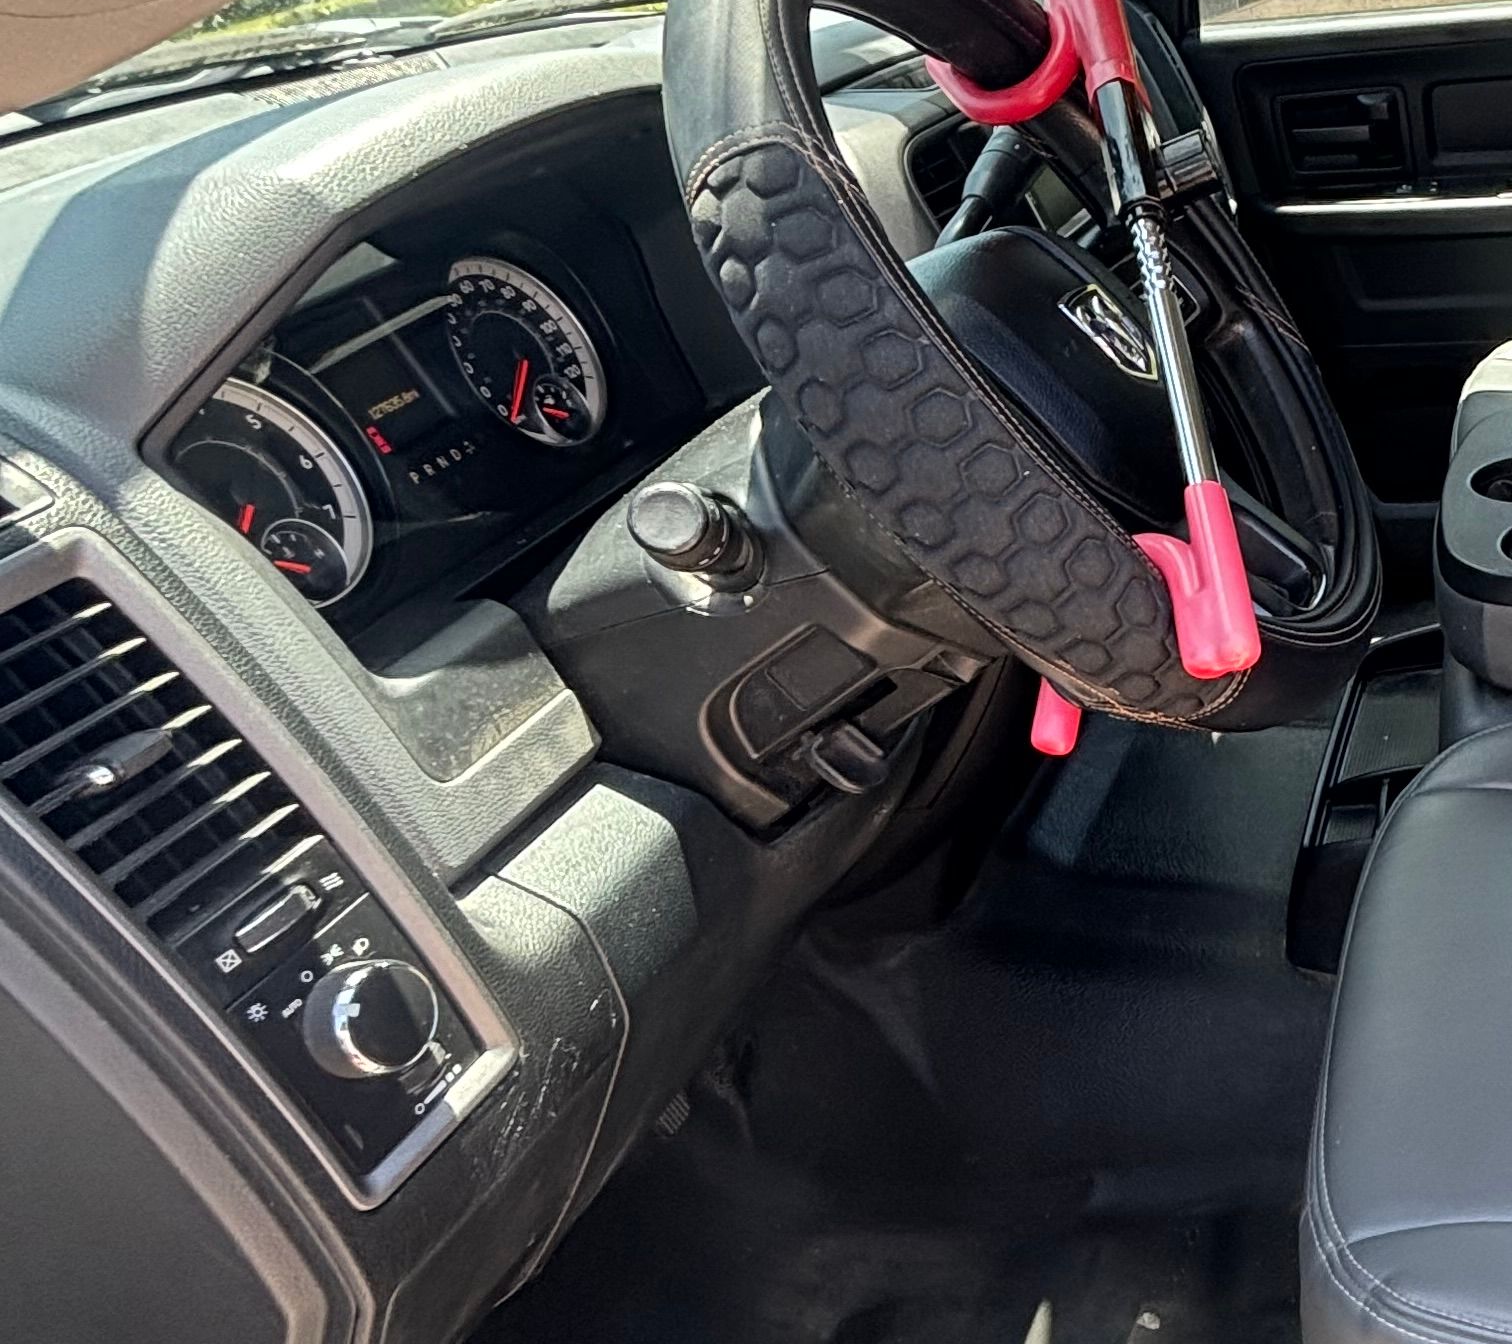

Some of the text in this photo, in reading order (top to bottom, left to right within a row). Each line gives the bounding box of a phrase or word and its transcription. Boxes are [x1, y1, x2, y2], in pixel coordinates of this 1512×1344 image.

[478, 278, 496, 293] 70
[245, 413, 263, 430] 5
[299, 454, 313, 469] 6
[408, 448, 462, 485] P R N D
[321, 504, 337, 519] 7
[281, 998, 303, 1018] AUTO
